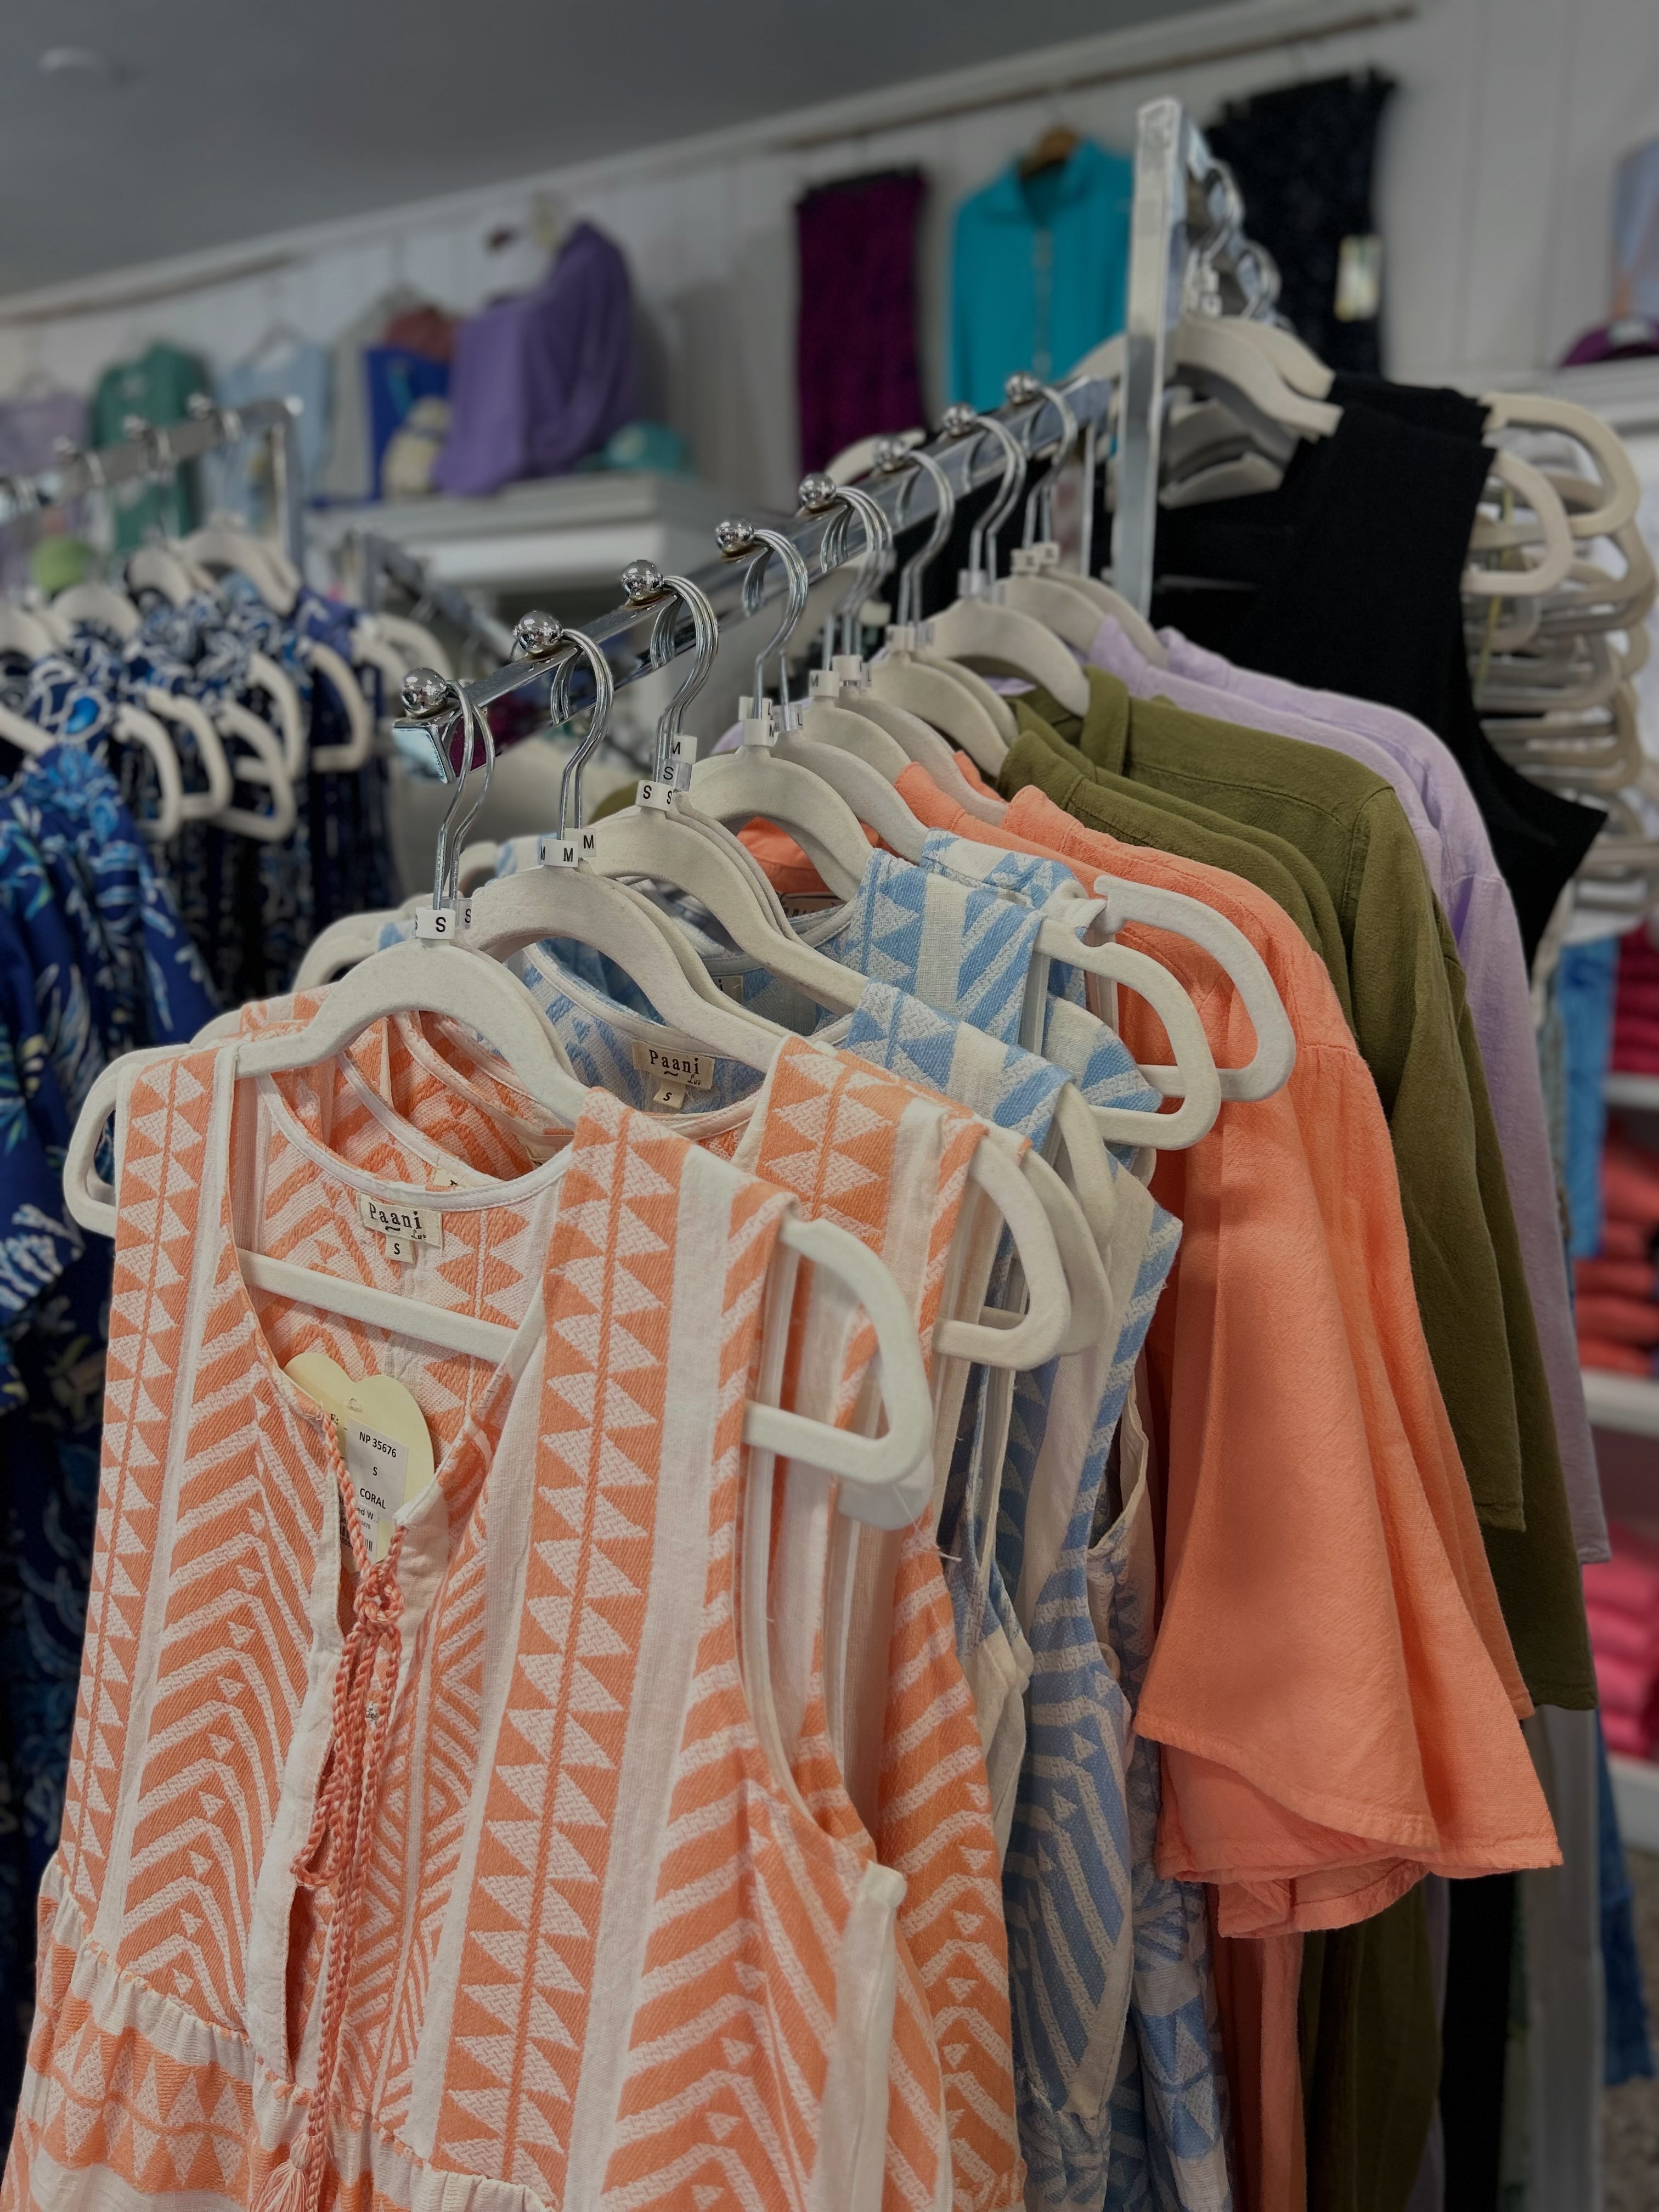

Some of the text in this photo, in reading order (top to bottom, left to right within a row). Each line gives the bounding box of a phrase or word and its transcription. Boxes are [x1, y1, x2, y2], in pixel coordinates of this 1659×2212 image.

[797, 712, 803, 726] L
[663, 766, 674, 780] S
[643, 785, 672, 804] S S
[583, 834, 594, 849] M
[563, 848, 573, 862] M
[465, 909, 471, 923] S
[436, 917, 447, 933] S
[648, 1049, 699, 1075] Paani
[663, 1092, 672, 1101] S
[369, 1202, 422, 1229] Paani
[394, 1243, 400, 1255] S
[359, 1431, 397, 1458] NP 35676
[373, 1466, 377, 1476] S
[360, 1488, 386, 1509] CORAL
